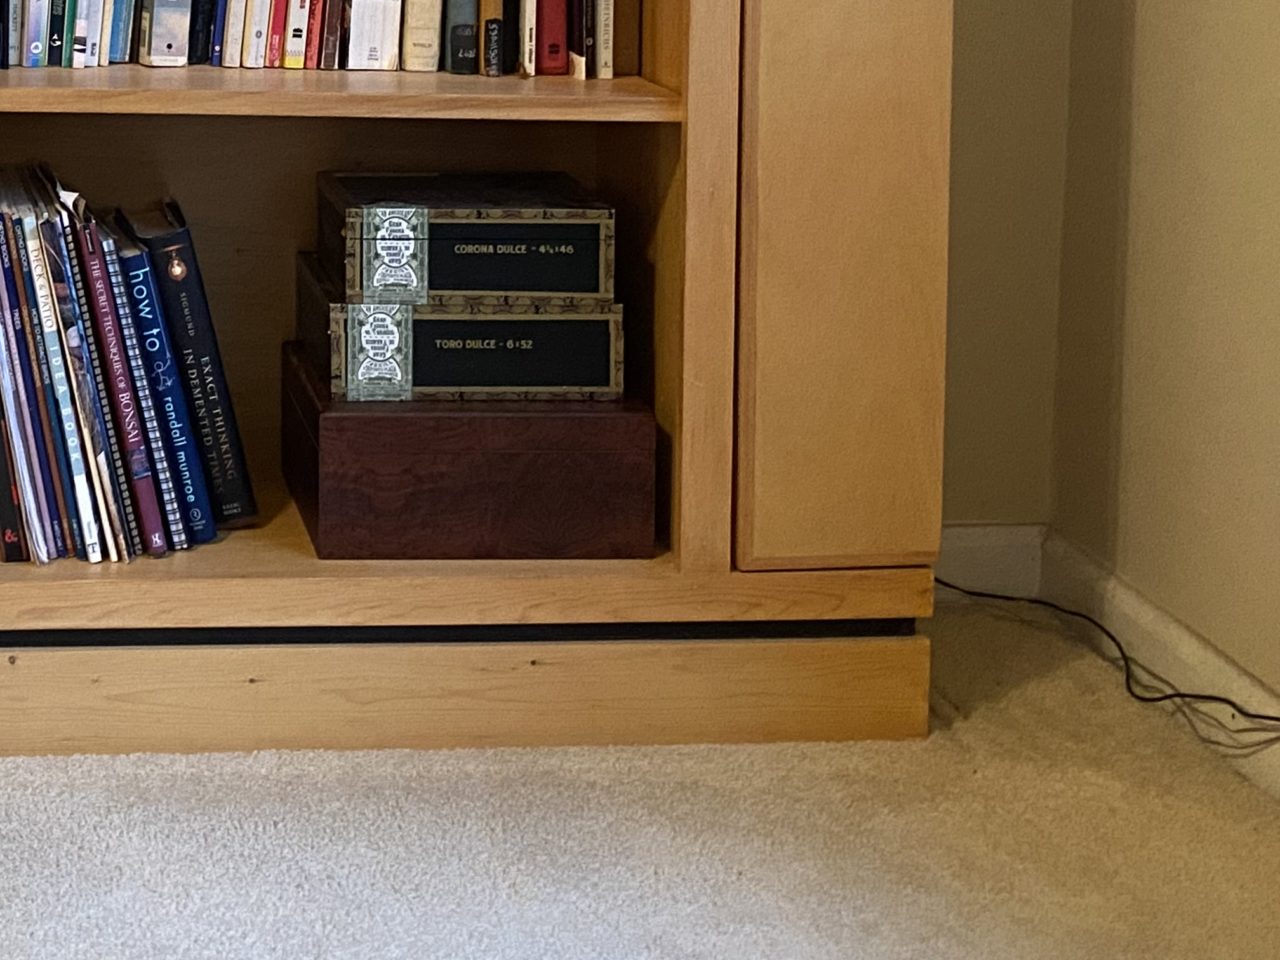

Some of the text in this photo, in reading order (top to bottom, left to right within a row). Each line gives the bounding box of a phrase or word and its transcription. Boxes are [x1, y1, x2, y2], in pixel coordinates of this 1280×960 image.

[603, 0, 611, 50] HEINRICHS
[0, 246, 11, 269] BOOKS
[14, 224, 29, 272] ORTHO BOOKS
[89, 258, 100, 279] THE
[453, 243, 527, 255] CORONA DULCE
[30, 247, 43, 279] DECK
[41, 291, 55, 330] PATIO
[94, 279, 110, 314] SECRET
[128, 267, 162, 352] how to
[11, 307, 22, 331] TREES
[30, 307, 39, 325] HOW
[33, 324, 42, 335] TO
[179, 291, 196, 337] SIGMUND
[35, 335, 48, 365] ATTRACT
[102, 313, 124, 376] TECHNIQUES
[434, 339, 497, 350] TORO DULCE
[49, 345, 81, 463] IDEA BOOK
[115, 376, 126, 390] OF
[118, 390, 141, 443] BONSAI
[182, 347, 225, 496] IN DEMENTED TIMES
[200, 355, 237, 481] EXACT THINKING
[163, 396, 196, 504] randall munroe
